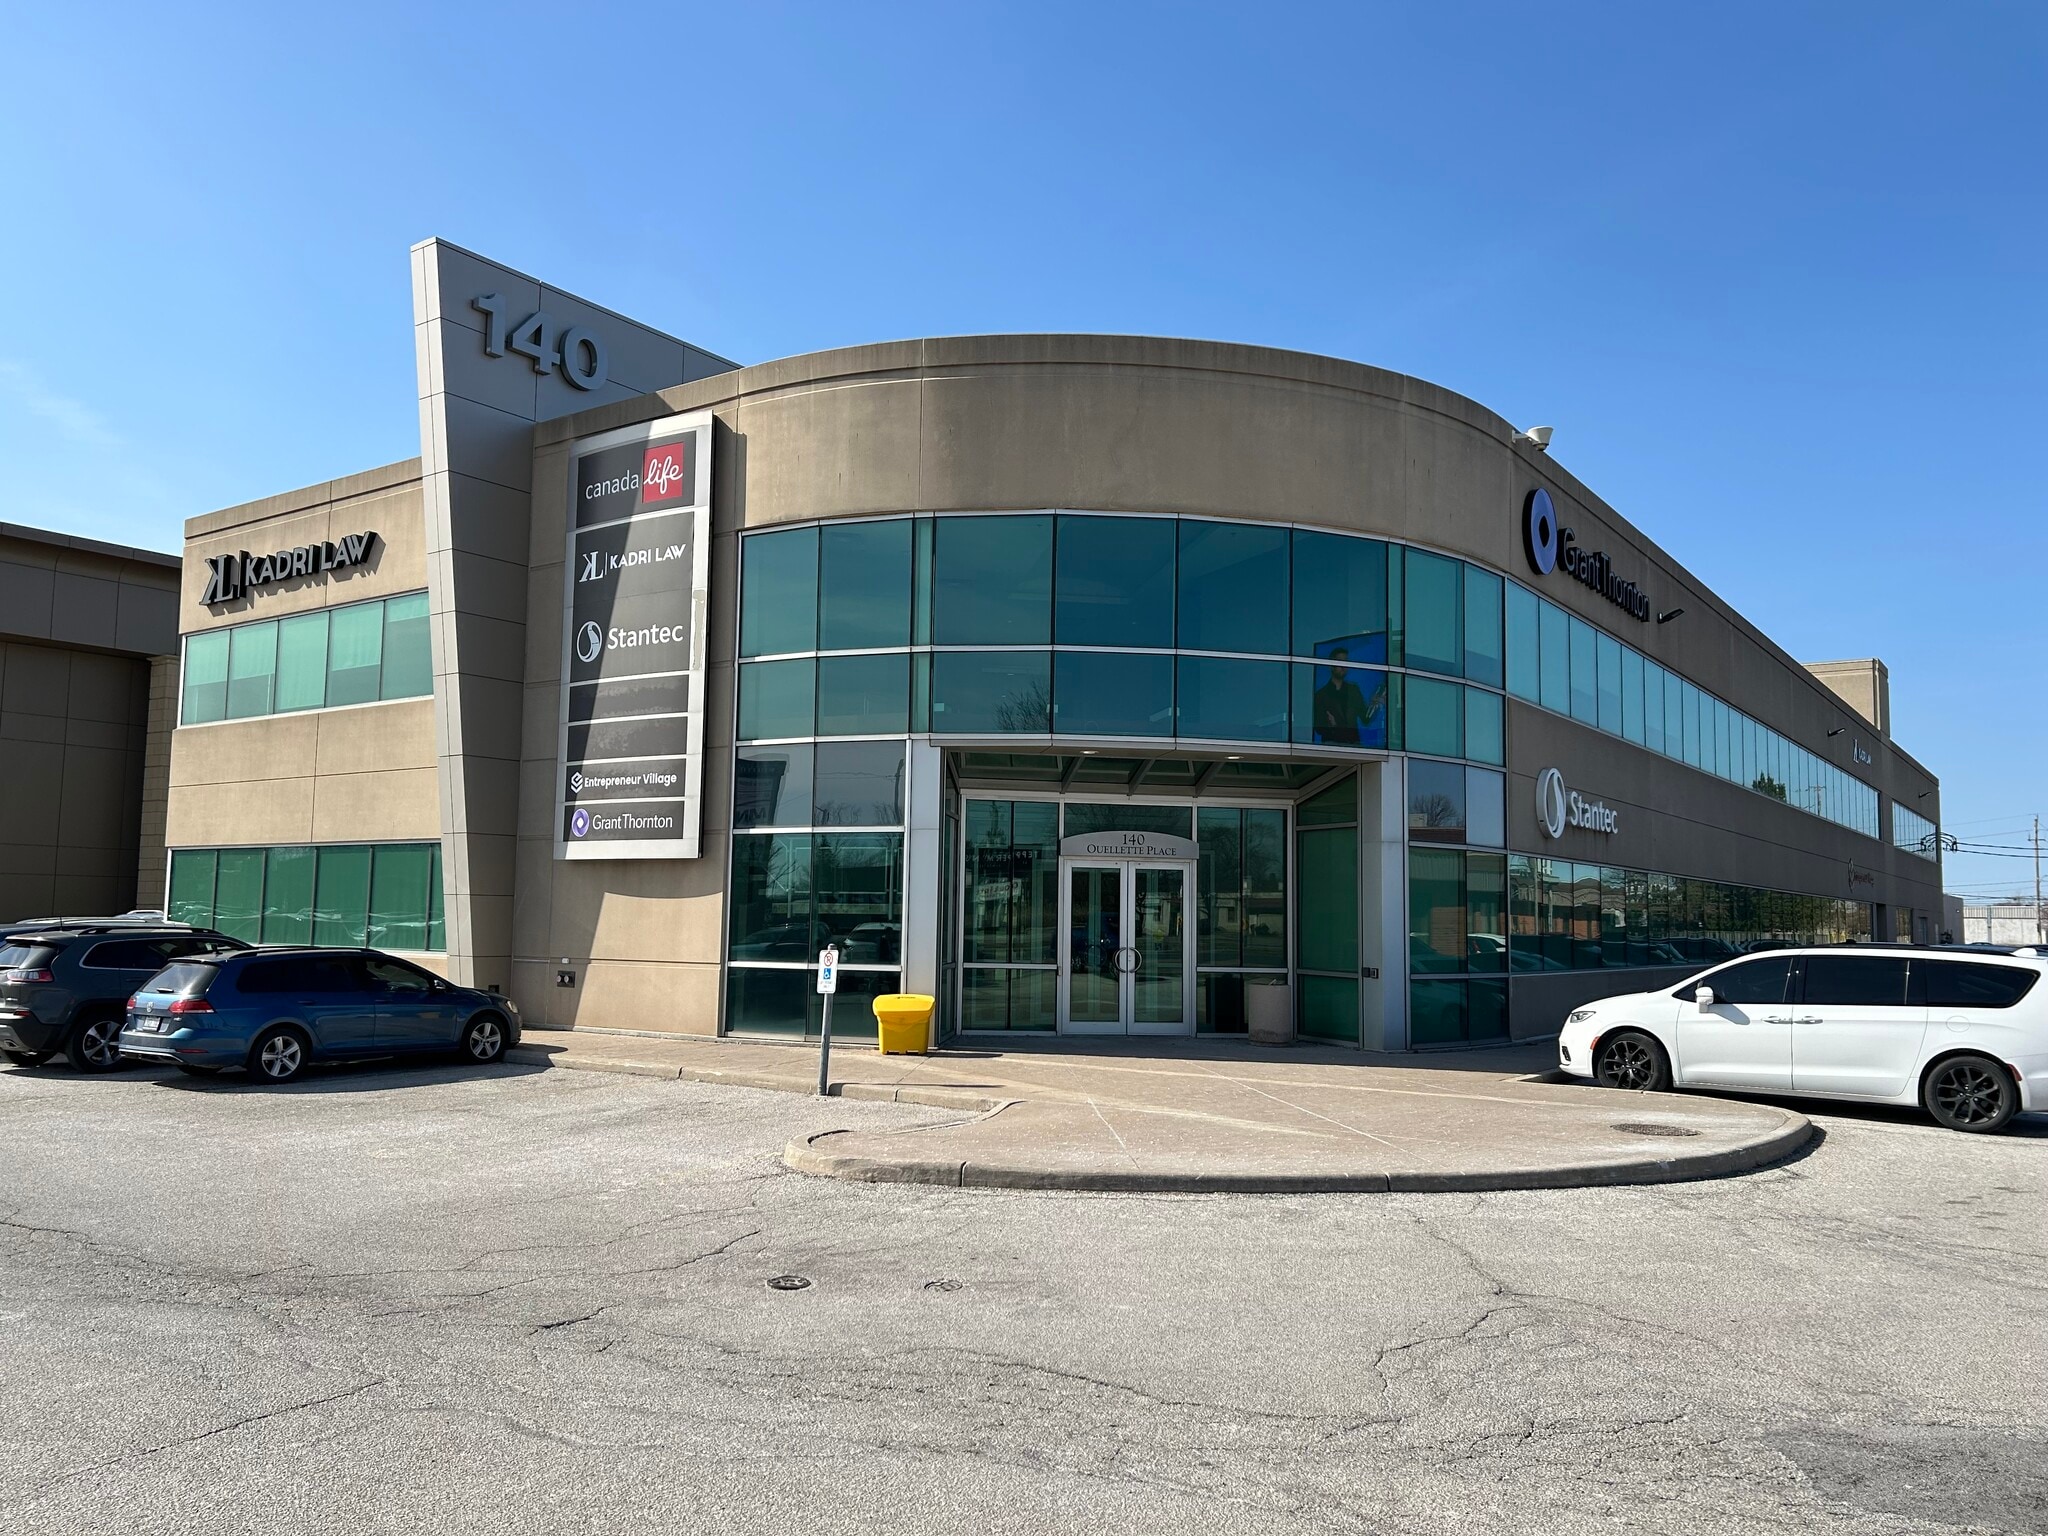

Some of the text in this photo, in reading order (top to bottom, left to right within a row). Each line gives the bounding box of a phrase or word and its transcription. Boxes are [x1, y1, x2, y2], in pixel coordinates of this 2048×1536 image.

[473, 293, 608, 391] 140
[585, 455, 683, 500] canada life
[245, 544, 315, 586] KADRI
[320, 531, 378, 571] LAW
[610, 549, 651, 569] KADRI
[655, 544, 686, 562] LAW
[1558, 527, 1649, 622] Grant Thornton
[607, 625, 683, 650] Stantec
[584, 773, 677, 789] Entrepreneur Village
[592, 813, 673, 830] Grant Thornton
[1569, 791, 1618, 834] Stantec
[1086, 843, 1176, 856] OUELLETTE PLACE
[1122, 834, 1145, 846] 140
